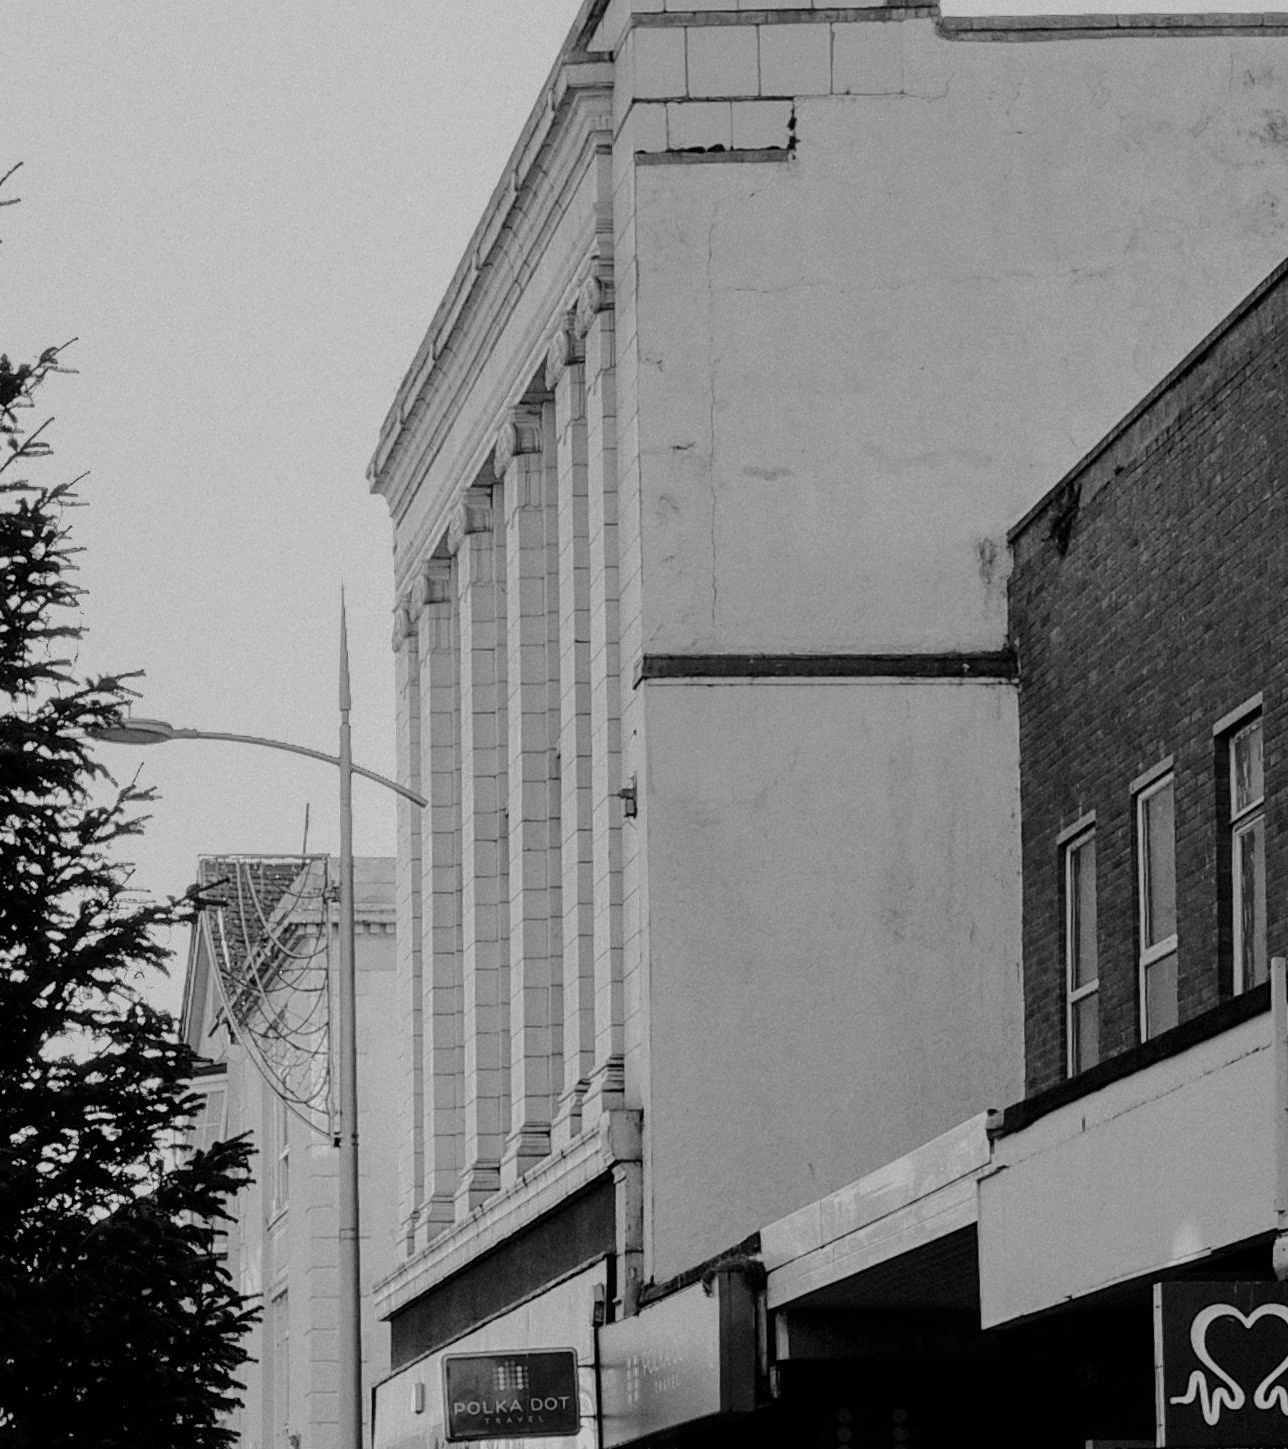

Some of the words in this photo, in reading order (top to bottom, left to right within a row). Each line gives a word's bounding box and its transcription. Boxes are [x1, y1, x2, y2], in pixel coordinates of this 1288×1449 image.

[454, 1399, 523, 1416] POLKA
[530, 1396, 570, 1412] DOT
[484, 1415, 545, 1424] TRAVEL
